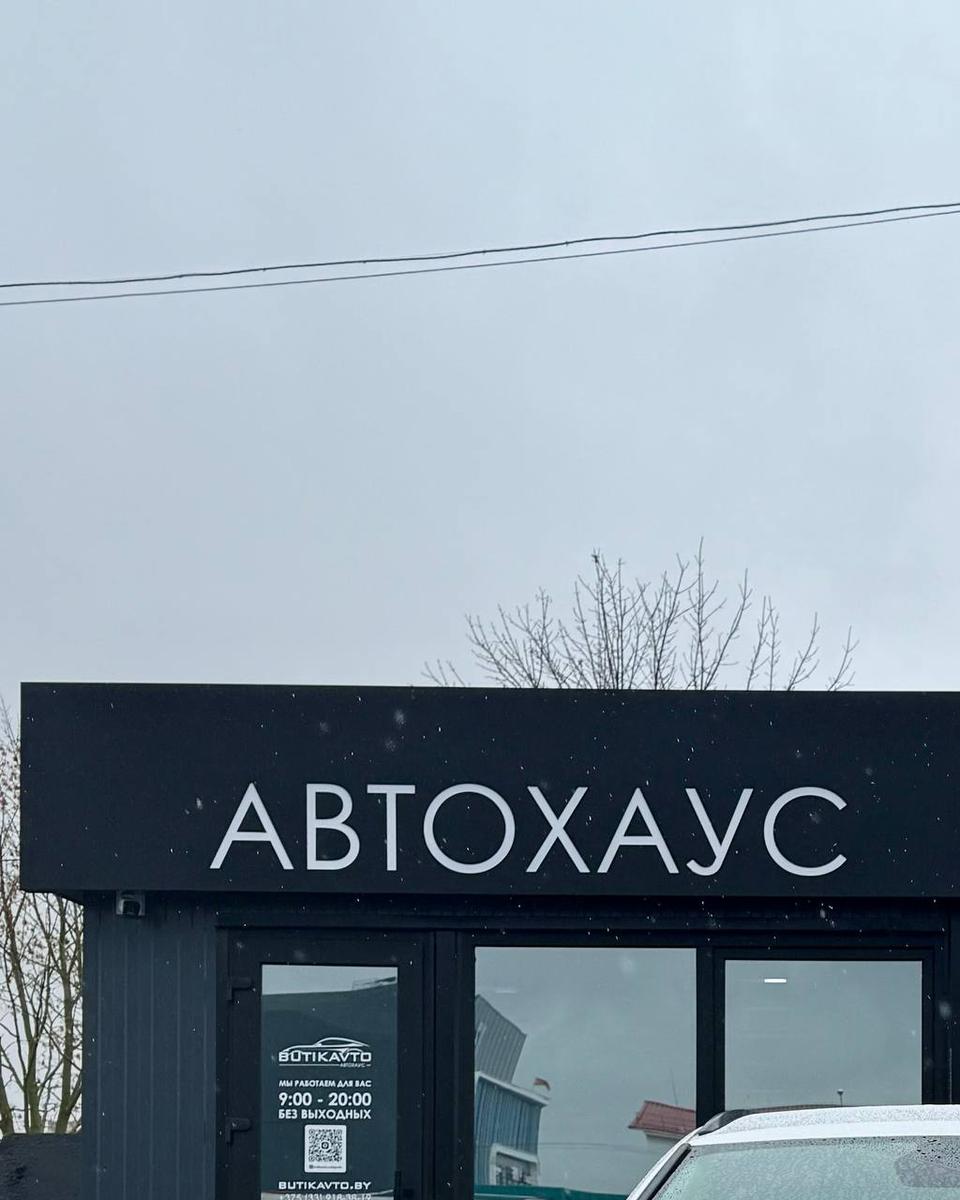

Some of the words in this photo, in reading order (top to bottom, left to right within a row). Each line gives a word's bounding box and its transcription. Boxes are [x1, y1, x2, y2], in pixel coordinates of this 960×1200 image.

[210, 781, 848, 877] АВТОХАУС
[278, 1051, 371, 1062] BUTIKAVTO
[337, 1080, 353, 1088] ДЛЯ
[278, 1092, 312, 1106] 9:00
[328, 1092, 372, 1106] 20:00
[278, 1109, 298, 1119] БЕЗ
[301, 1109, 372, 1120] ВЫХОДНЫХ
[278, 1181, 371, 1190] BUTIKAVTO.BY
